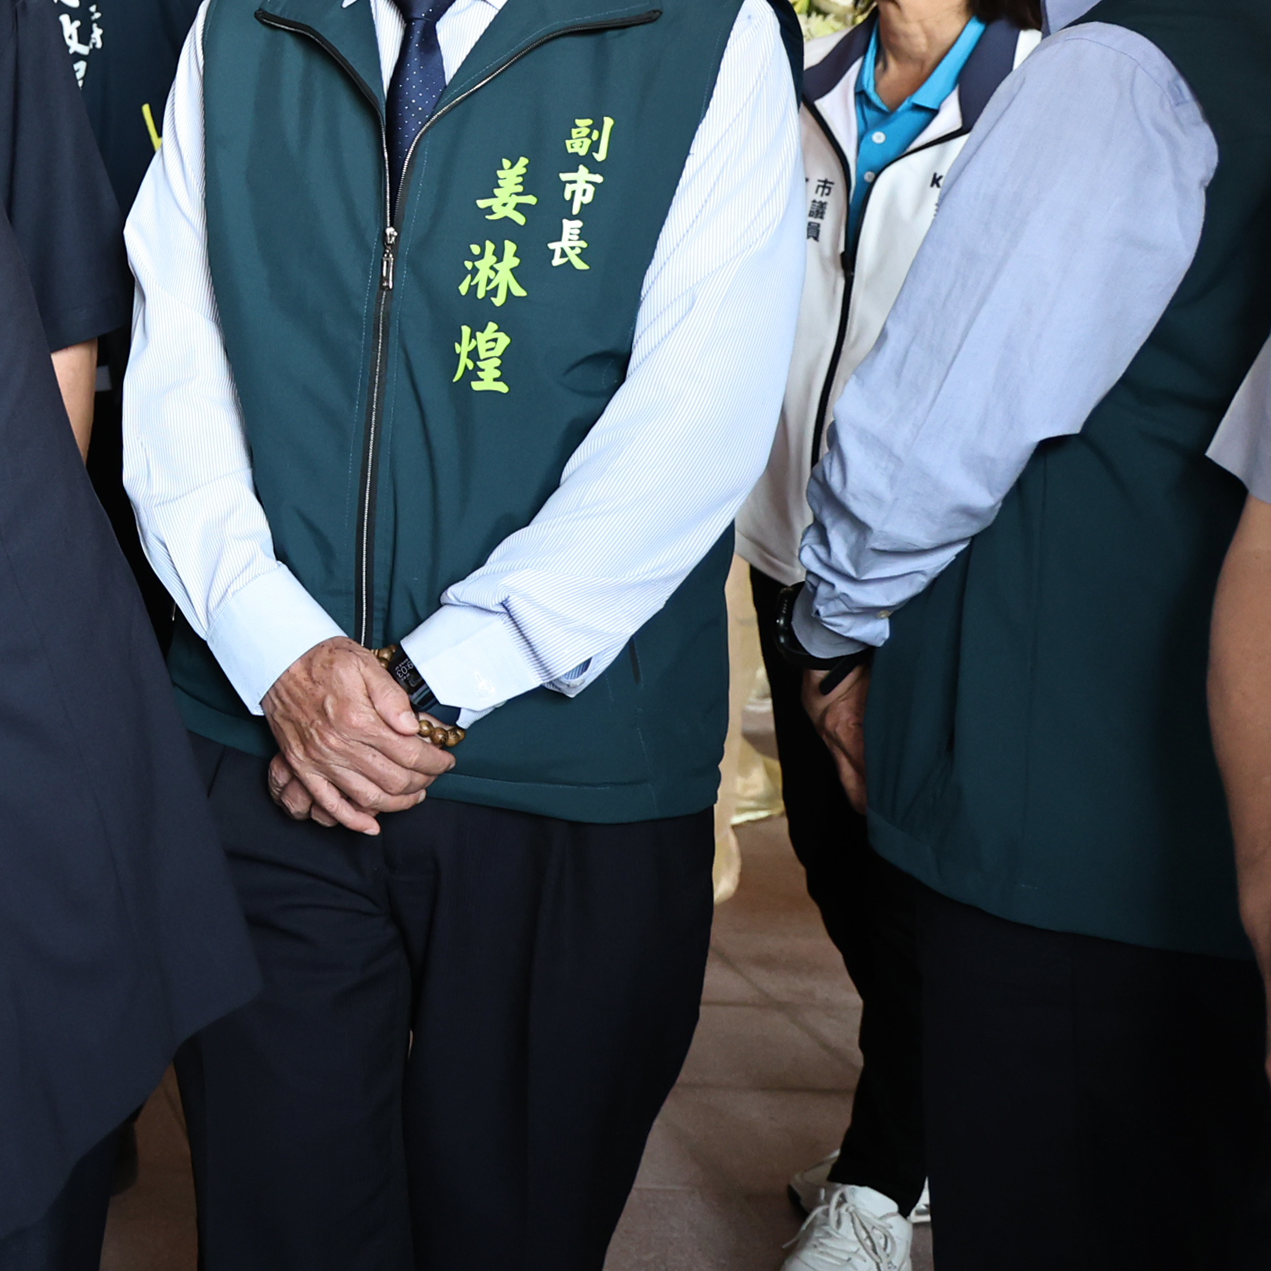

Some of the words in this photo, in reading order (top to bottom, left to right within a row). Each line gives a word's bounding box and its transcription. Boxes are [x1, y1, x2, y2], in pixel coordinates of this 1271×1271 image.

[547, 116, 615, 270] 副市長
[806, 178, 835, 242] 市議員
[452, 156, 538, 394] 姜淋煌
